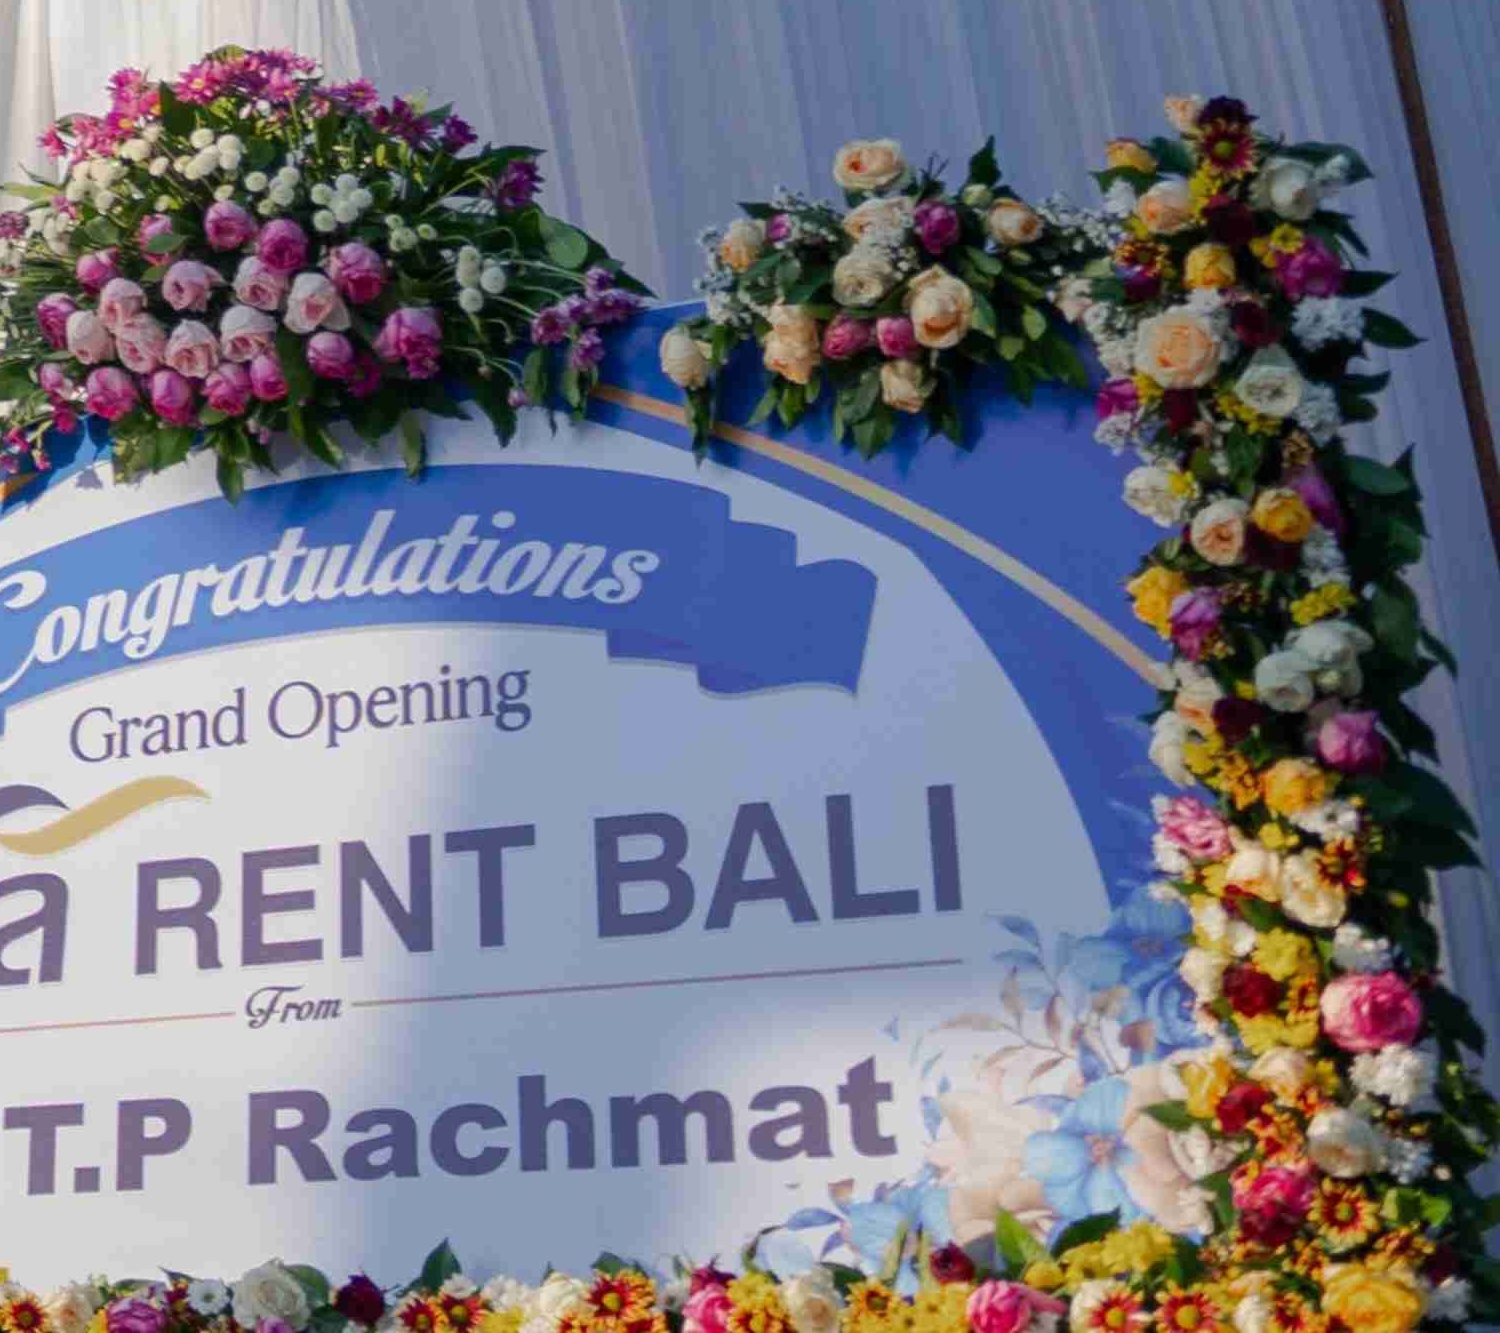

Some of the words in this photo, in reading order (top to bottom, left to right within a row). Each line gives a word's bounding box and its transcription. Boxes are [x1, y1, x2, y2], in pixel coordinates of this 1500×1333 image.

[69, 687, 249, 764] Grand
[266, 663, 533, 748] Opening
[133, 824, 537, 976] RENT
[592, 784, 964, 939] BALI
[243, 986, 343, 1031] From
[3, 1097, 194, 1197] T.P
[245, 1055, 899, 1188] Rachmat
